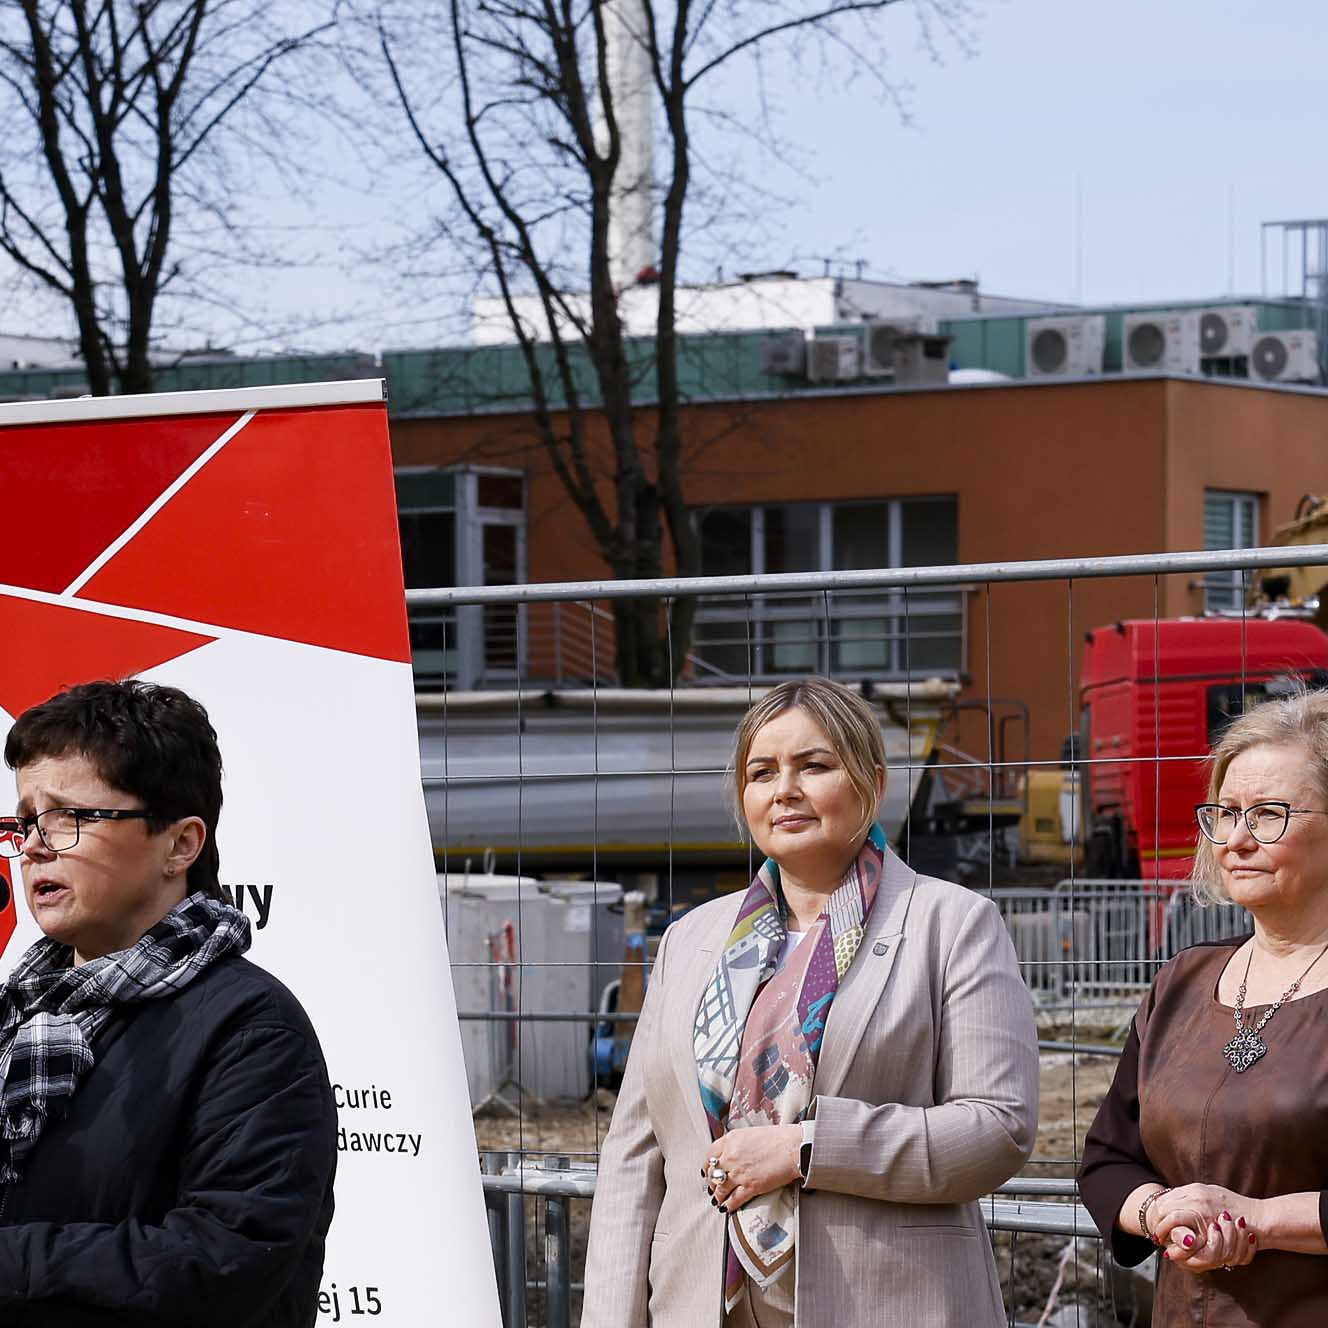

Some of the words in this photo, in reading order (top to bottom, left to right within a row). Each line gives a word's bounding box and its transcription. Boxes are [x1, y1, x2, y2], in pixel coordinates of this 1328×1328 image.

[332, 1084, 392, 1110] Curie
[337, 1127, 422, 1157] dawczy
[349, 1286, 382, 1316] 15
